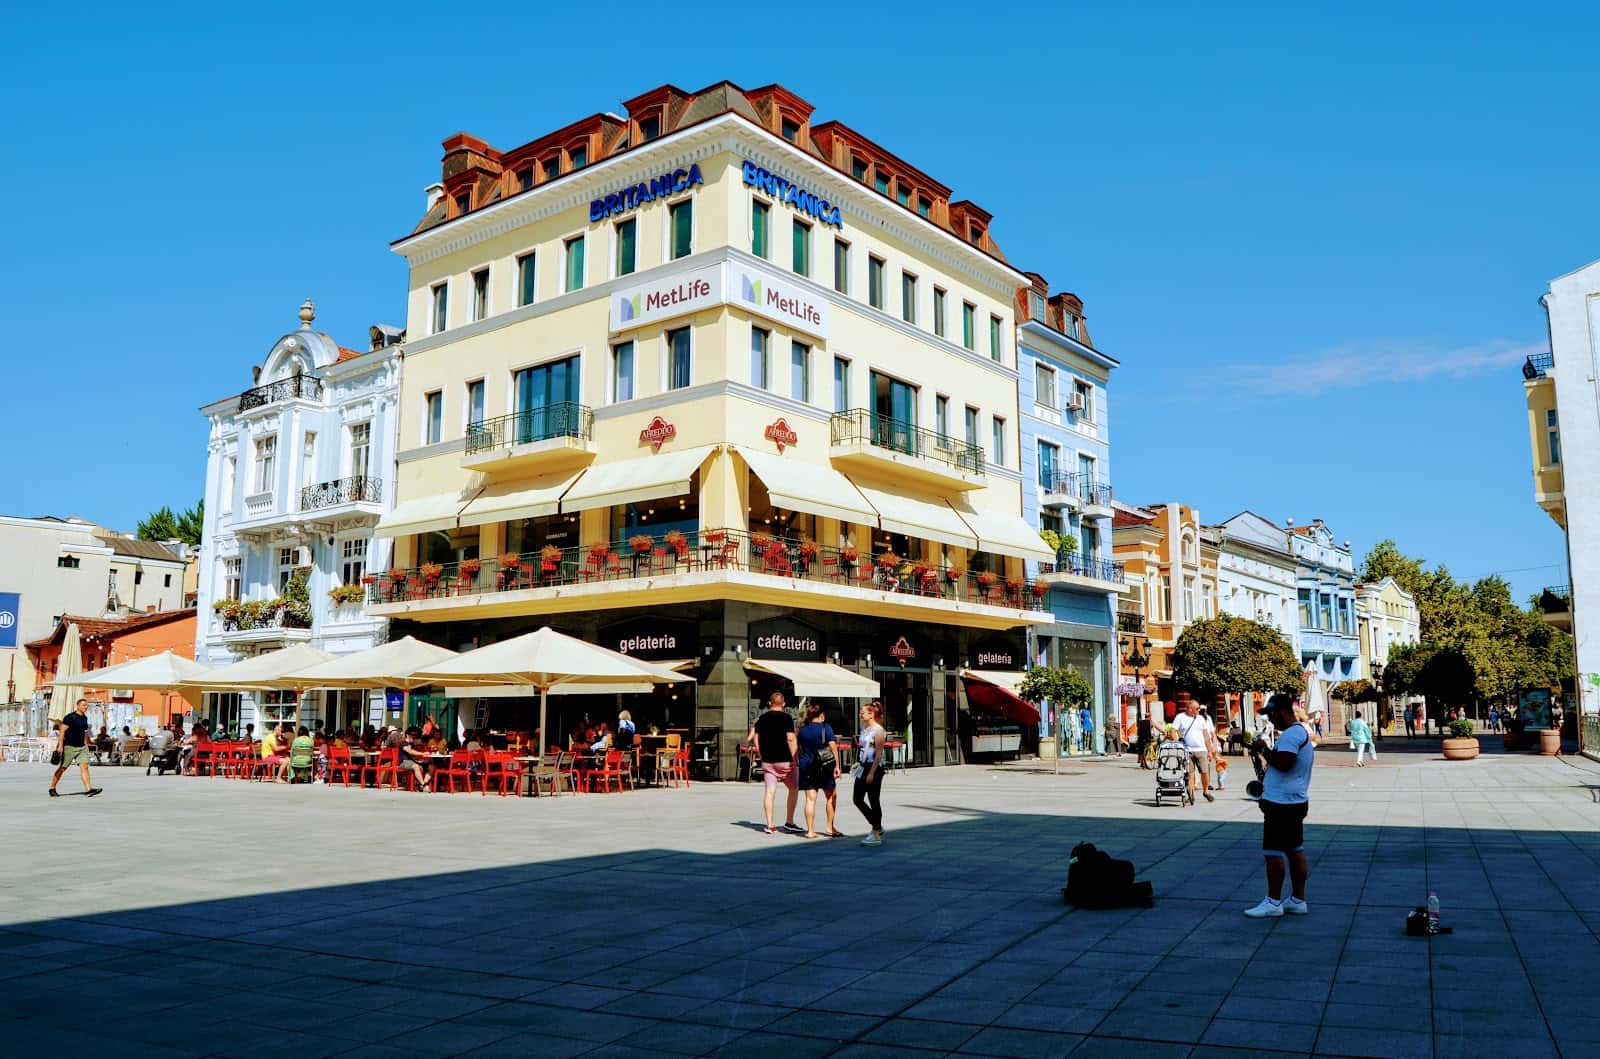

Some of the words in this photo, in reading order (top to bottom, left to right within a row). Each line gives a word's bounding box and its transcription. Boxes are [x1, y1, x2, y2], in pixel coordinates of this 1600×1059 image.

[589, 163, 704, 223] BRITANICA
[742, 160, 843, 229] BRITANICA
[646, 280, 711, 311] MetLife
[767, 288, 821, 325] MetLife
[620, 634, 675, 653] gelateria
[757, 634, 816, 651] caffetteria
[978, 651, 1012, 666] gelateria
